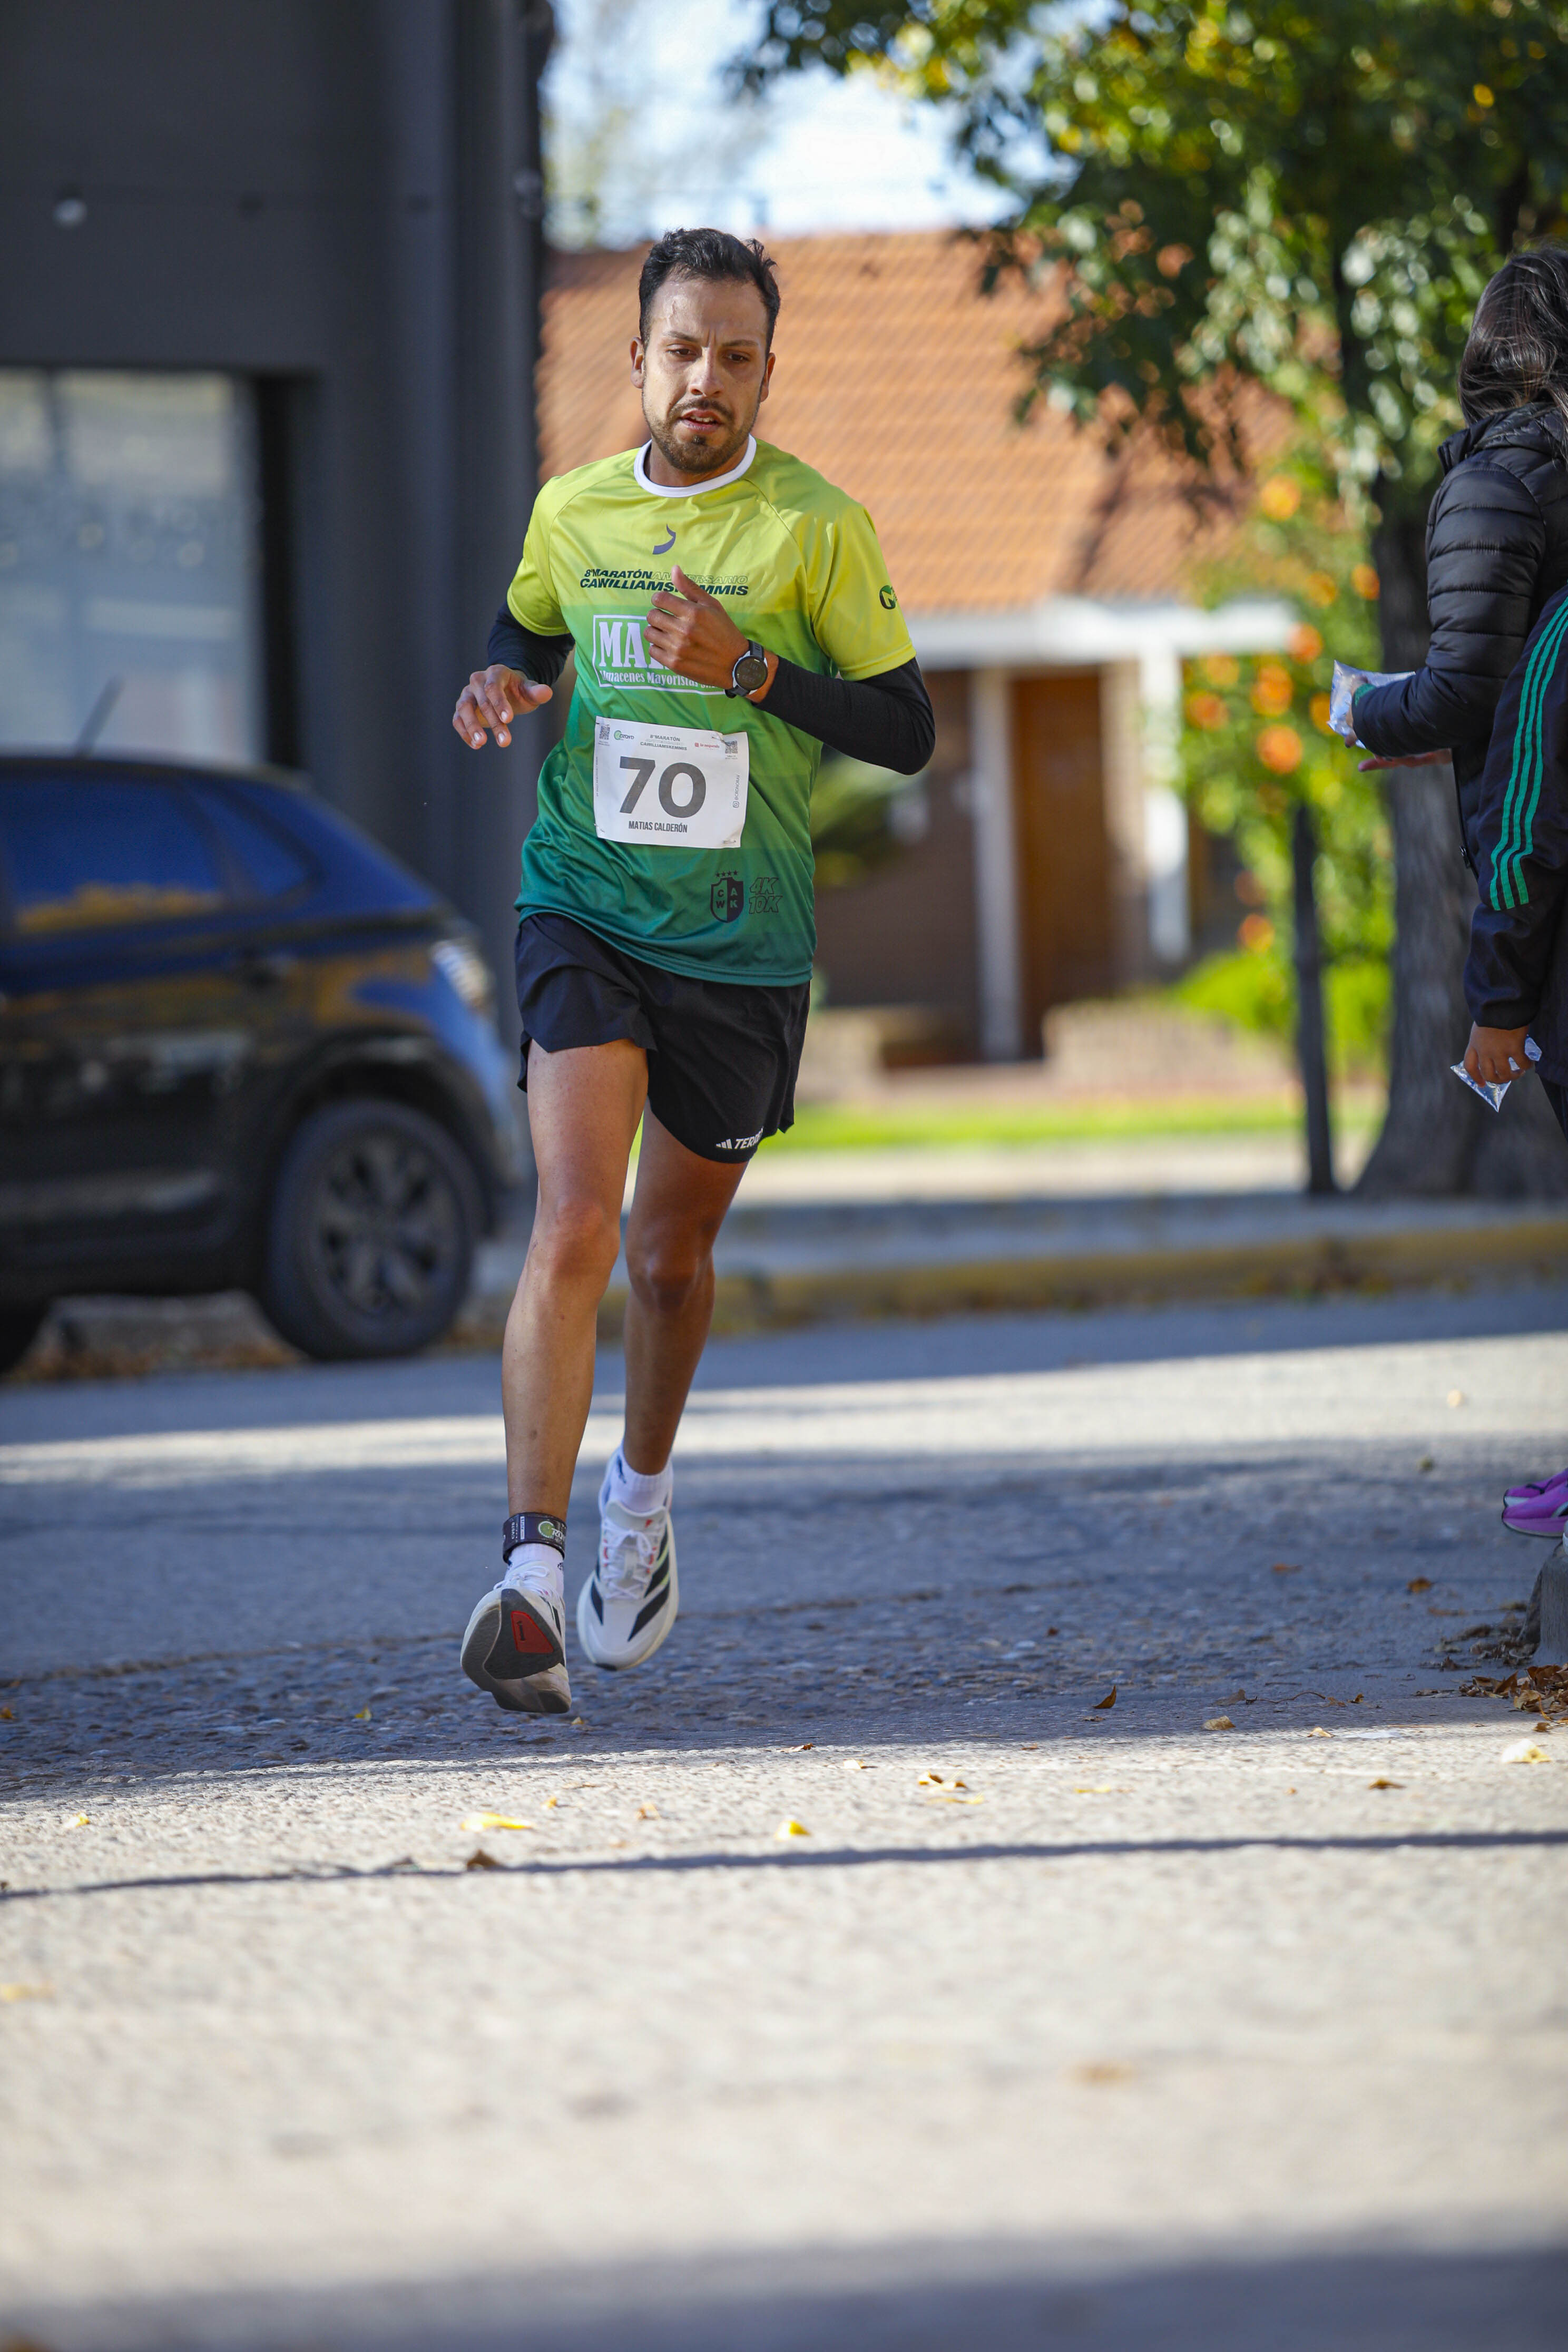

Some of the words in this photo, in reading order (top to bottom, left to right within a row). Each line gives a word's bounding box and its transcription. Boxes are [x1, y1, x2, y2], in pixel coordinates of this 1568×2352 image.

[580, 578, 749, 595] CAWILLIAMSMMIS
[651, 571, 748, 584] ANERSARIO
[599, 622, 670, 670] MA
[619, 756, 706, 818] 70
[629, 820, 653, 830] MATIAS
[654, 822, 688, 833] CALDERÓN
[749, 877, 779, 895] 4K
[749, 895, 783, 914] 10K
